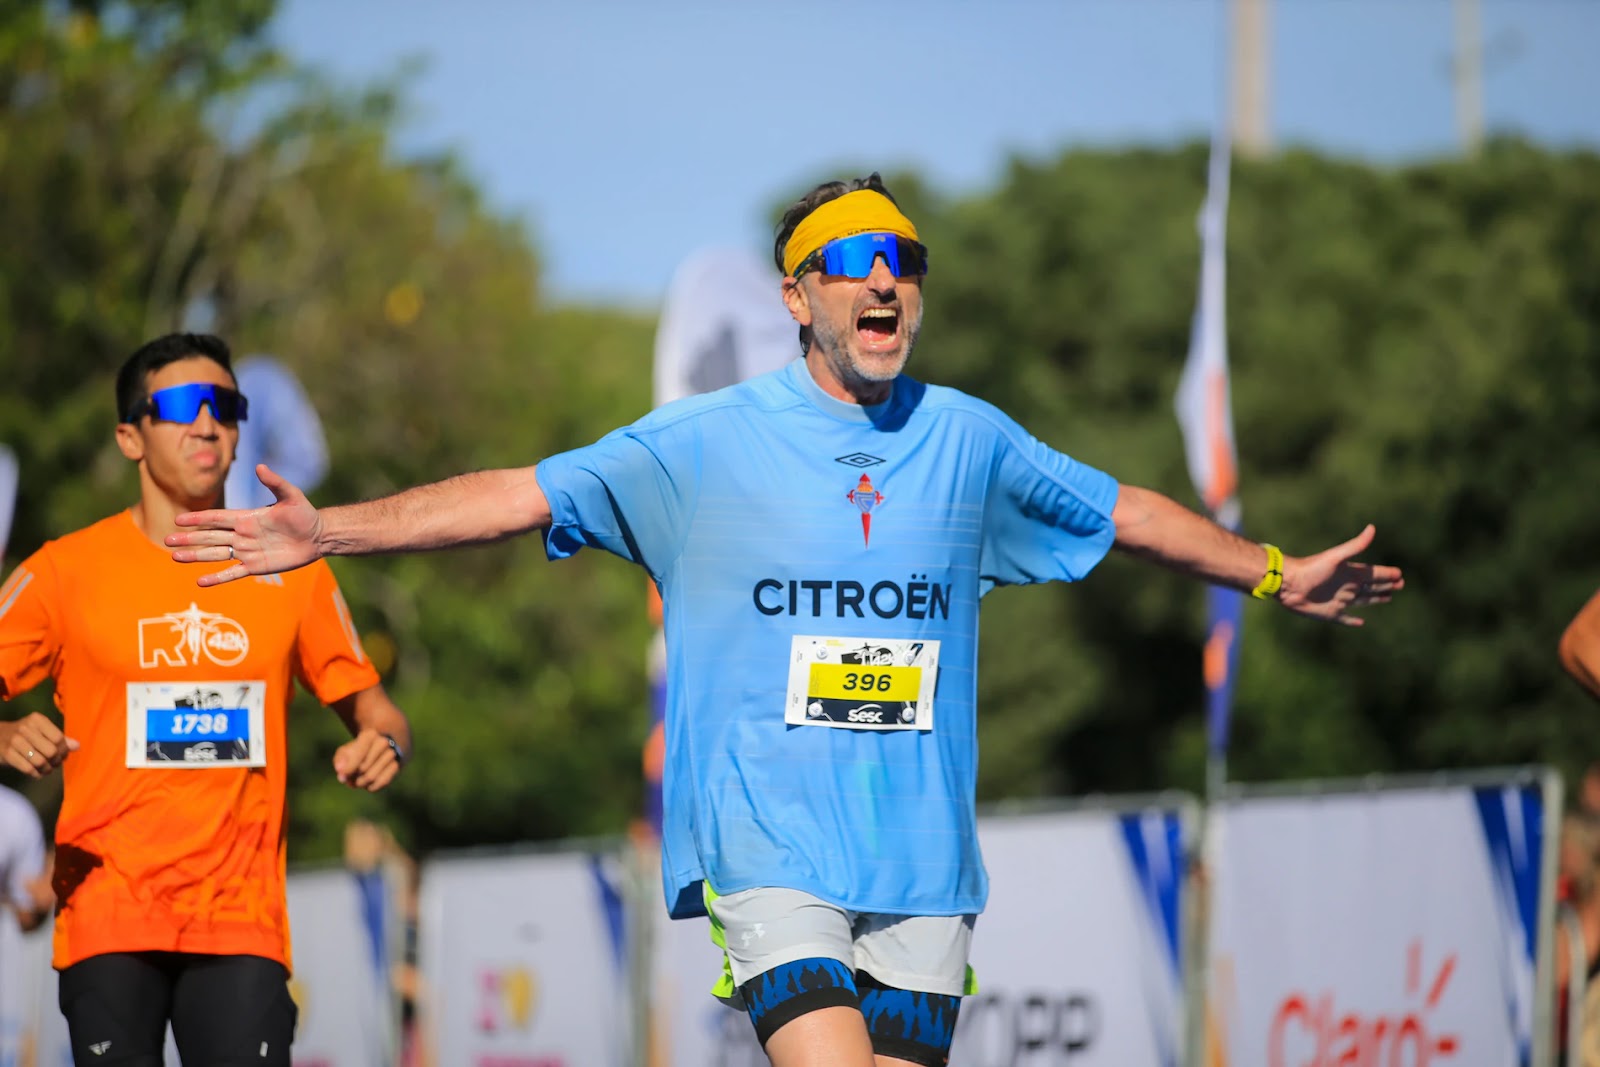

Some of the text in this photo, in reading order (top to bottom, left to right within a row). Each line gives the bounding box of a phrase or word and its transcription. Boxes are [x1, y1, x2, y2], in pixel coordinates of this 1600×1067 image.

[753, 573, 952, 620] CITROËN
[842, 672, 892, 692] 396
[171, 713, 228, 735] 1738
